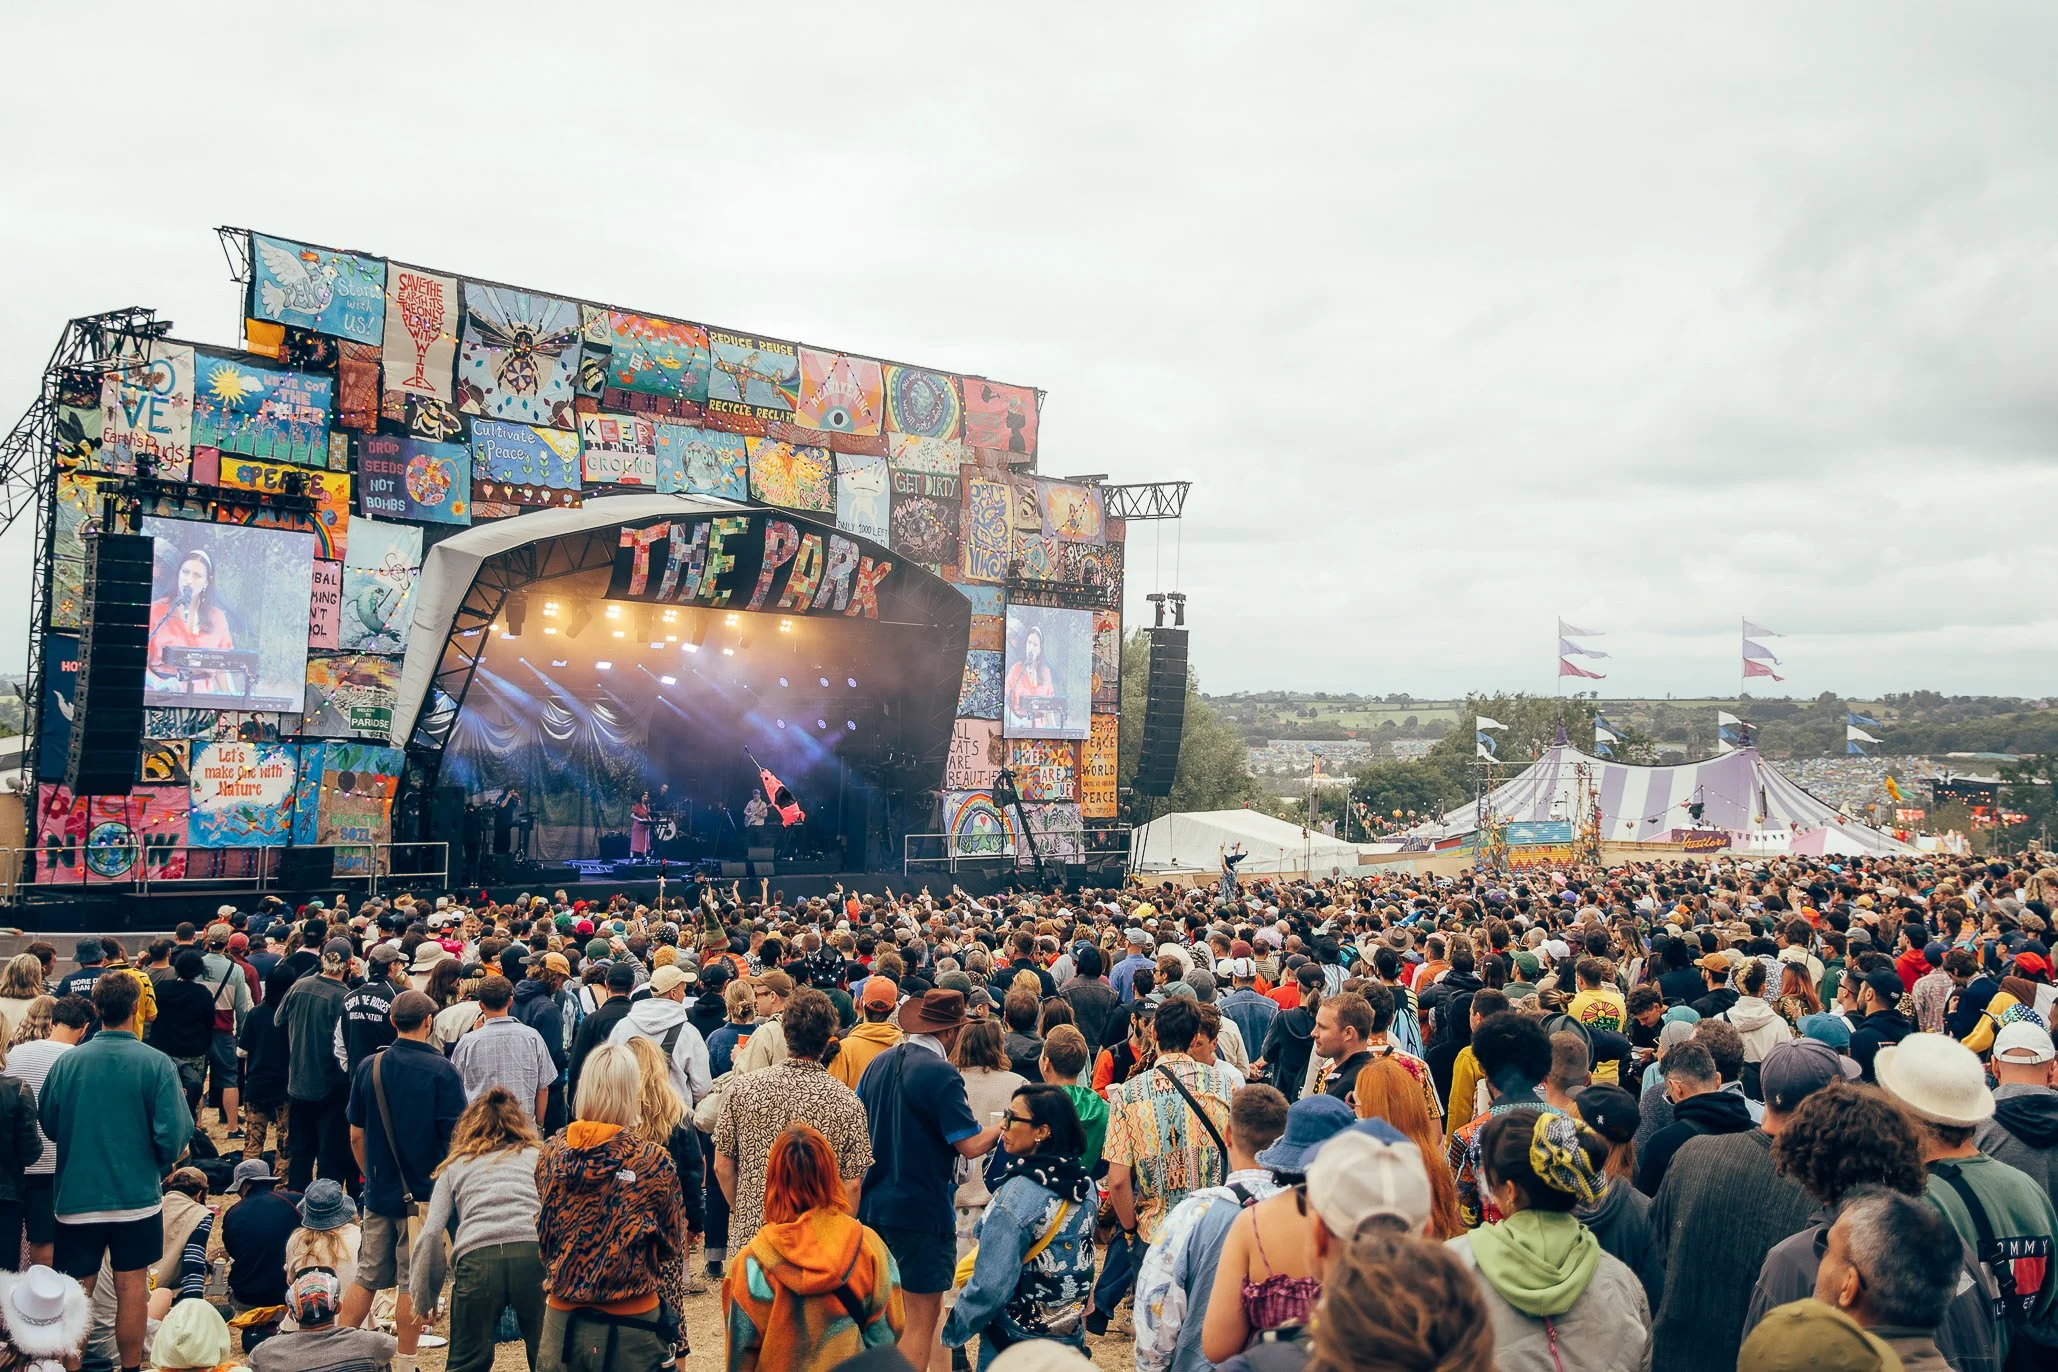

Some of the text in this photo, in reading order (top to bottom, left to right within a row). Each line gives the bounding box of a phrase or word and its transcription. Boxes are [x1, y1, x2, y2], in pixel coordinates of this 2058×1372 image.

[337, 279, 382, 300] Starts
[399, 273, 443, 298] SAVE THE
[346, 299, 373, 312] with
[398, 291, 428, 307] EARTH
[399, 301, 446, 322] THE ONLY
[402, 313, 444, 333] PLANET
[407, 326, 440, 343] WITH
[709, 331, 794, 356] REDUCE REUSE
[414, 339, 430, 388] WINE
[304, 380, 327, 394] GOT
[278, 388, 312, 406] THE
[709, 399, 752, 416] RECYCLE
[103, 427, 144, 448] Earth's
[473, 421, 536, 444] Cultivate
[584, 419, 650, 442] KEEP
[662, 424, 738, 446] STAY WILD
[368, 441, 400, 455] DROP
[486, 439, 525, 461] Peace
[590, 440, 648, 455] IT IN THE
[365, 460, 405, 475] SEEDS
[587, 456, 653, 474] GROUND
[248, 465, 325, 495] PEAE
[370, 479, 395, 493] NOT
[894, 472, 957, 497] GET DIRTY
[366, 496, 406, 512] BOMBS
[858, 524, 872, 535] 1000
[872, 527, 888, 537] LEFT
[618, 516, 893, 620] THE PARK
[312, 572, 338, 586] BAL
[948, 740, 979, 756] CATS
[1083, 736, 1115, 748] PEACE
[218, 747, 245, 763] Let's
[948, 755, 971, 770] ARE
[1022, 750, 1038, 764] WE
[204, 764, 283, 780] make One with
[1041, 768, 1061, 782] ARE
[1081, 764, 1115, 777] WORLD
[218, 781, 262, 797] Nature
[1082, 791, 1115, 804] PEACE
[67, 794, 157, 818] ACT
[331, 813, 384, 829] HEALTHY
[340, 826, 373, 843] SOIL
[70, 978, 92, 987] MORE
[70, 984, 90, 993] THAN
[370, 995, 391, 1014] ROSES
